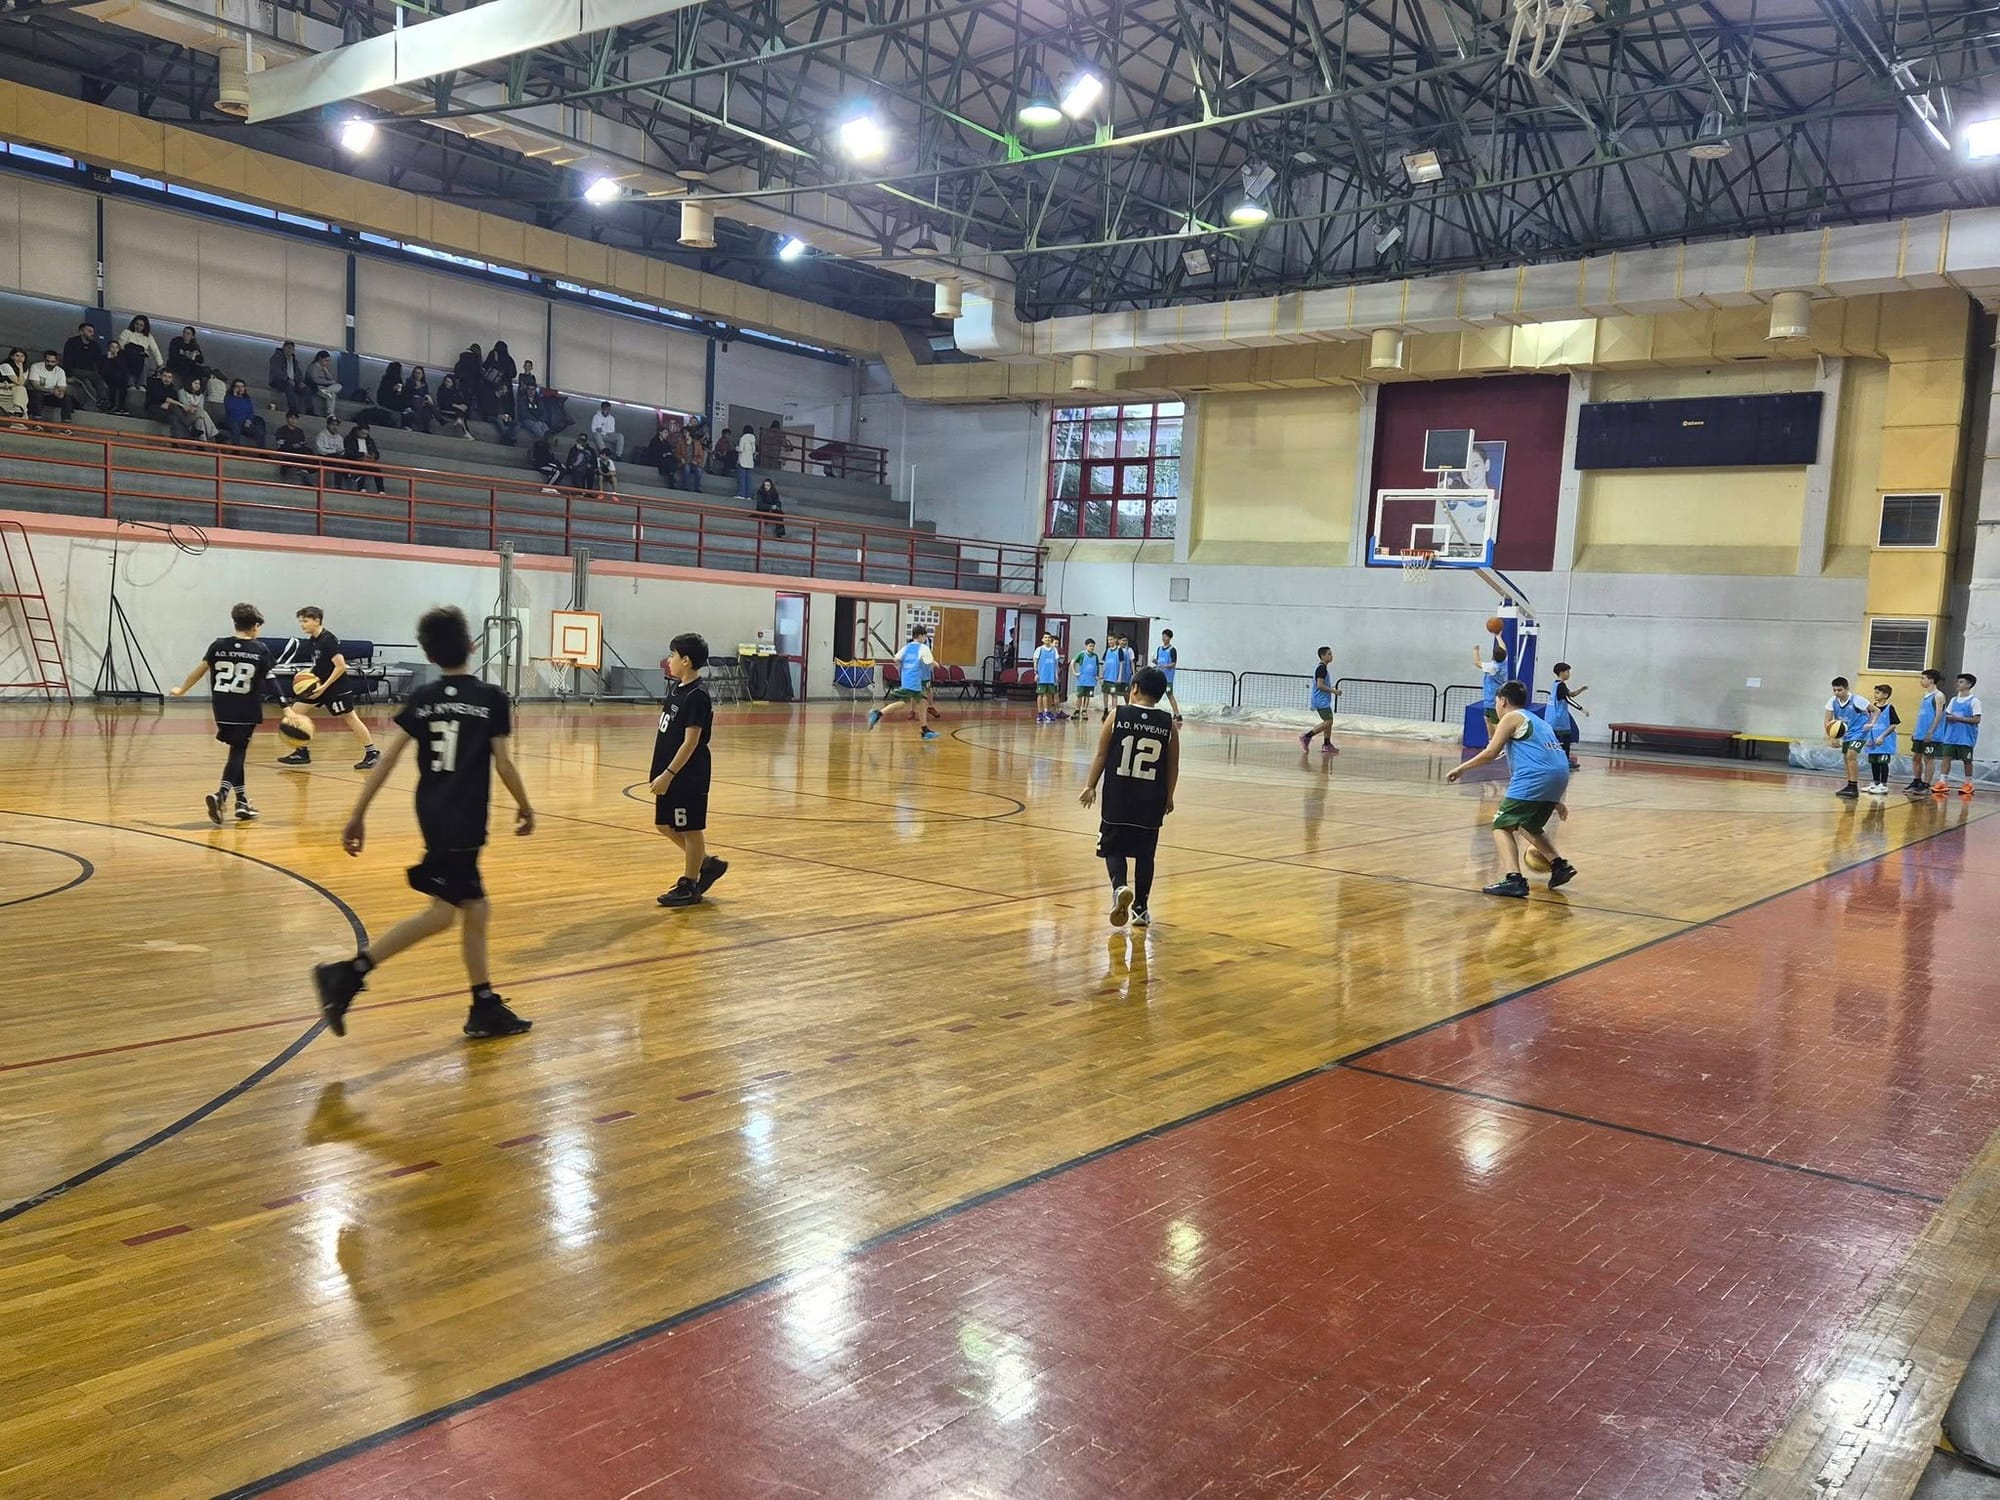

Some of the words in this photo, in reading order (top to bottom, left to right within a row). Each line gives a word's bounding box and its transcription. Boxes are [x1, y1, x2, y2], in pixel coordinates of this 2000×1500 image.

[213, 661, 256, 694] 28
[1133, 722, 1169, 736] ΚΥΨΕΛΗΣ
[429, 720, 460, 772] 31
[1116, 735, 1162, 780] 12
[674, 807, 687, 827] 6
